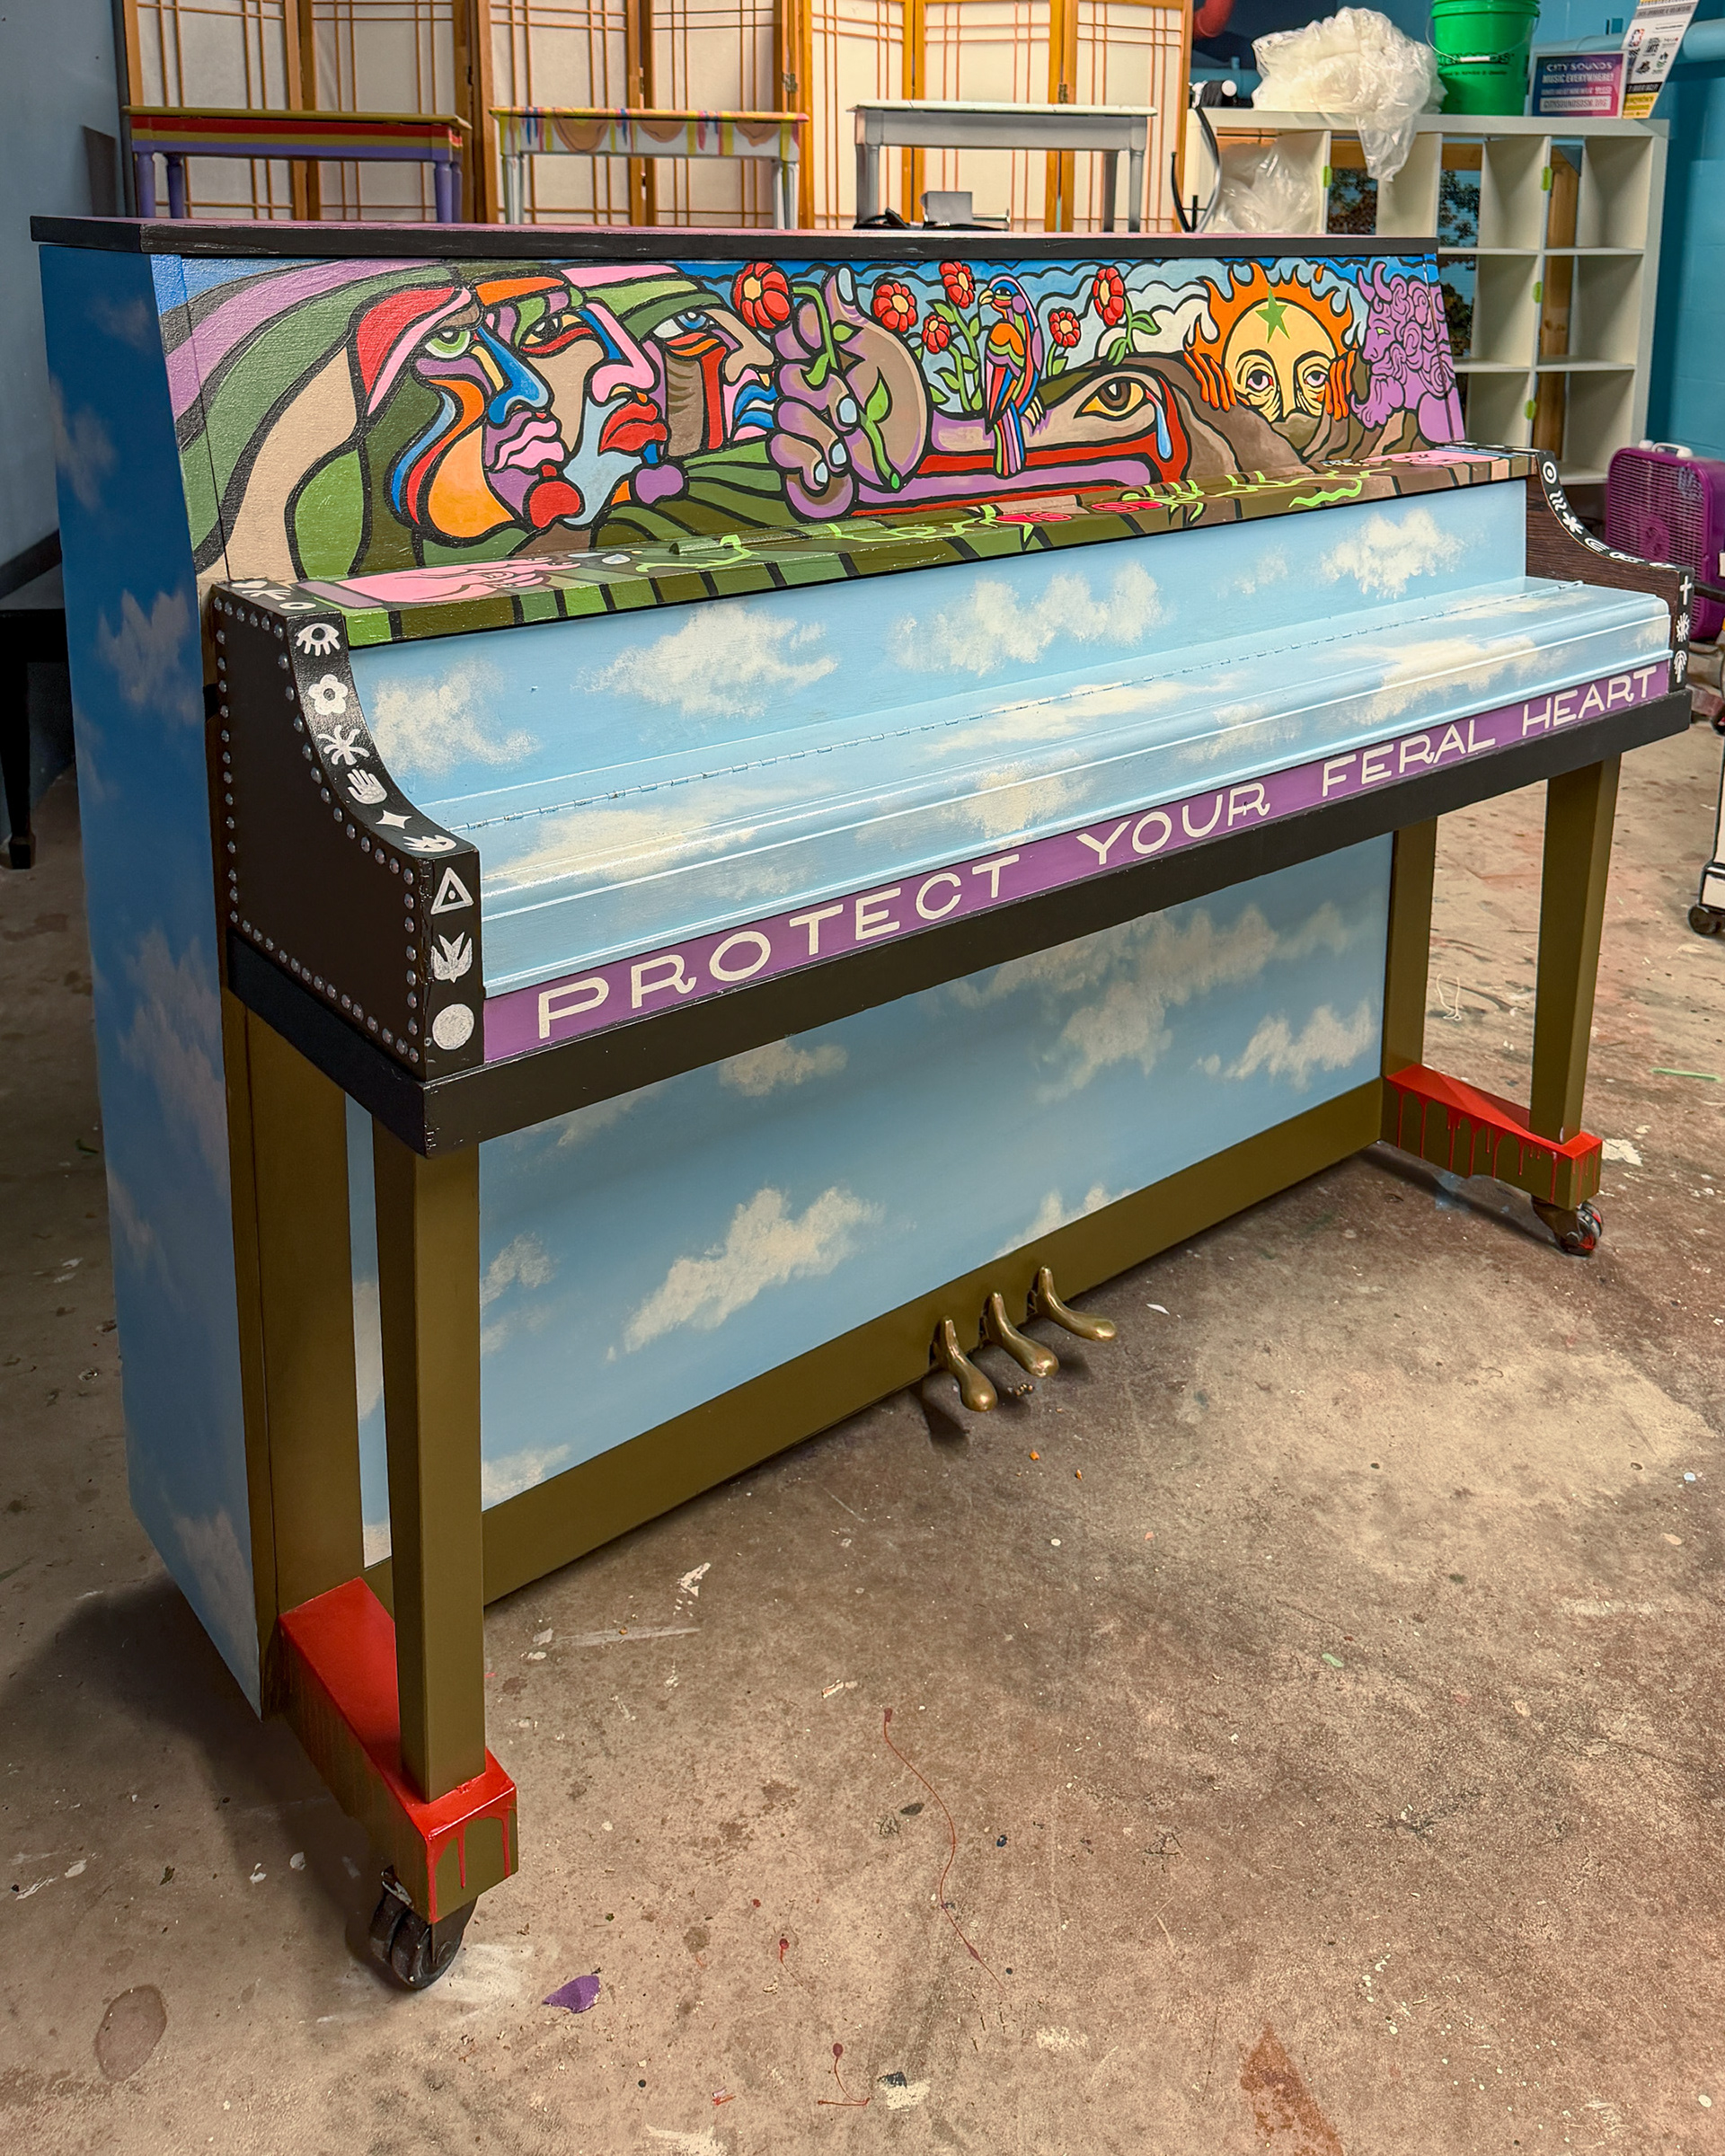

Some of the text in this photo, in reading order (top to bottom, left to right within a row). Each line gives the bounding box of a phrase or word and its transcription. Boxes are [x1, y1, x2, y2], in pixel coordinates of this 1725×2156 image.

[1546, 62, 1613, 72] CITY SOUNDS
[1542, 74, 1565, 84] MUSIC
[538, 666, 1657, 1039] PROTECT YOUR FERAL HEART
